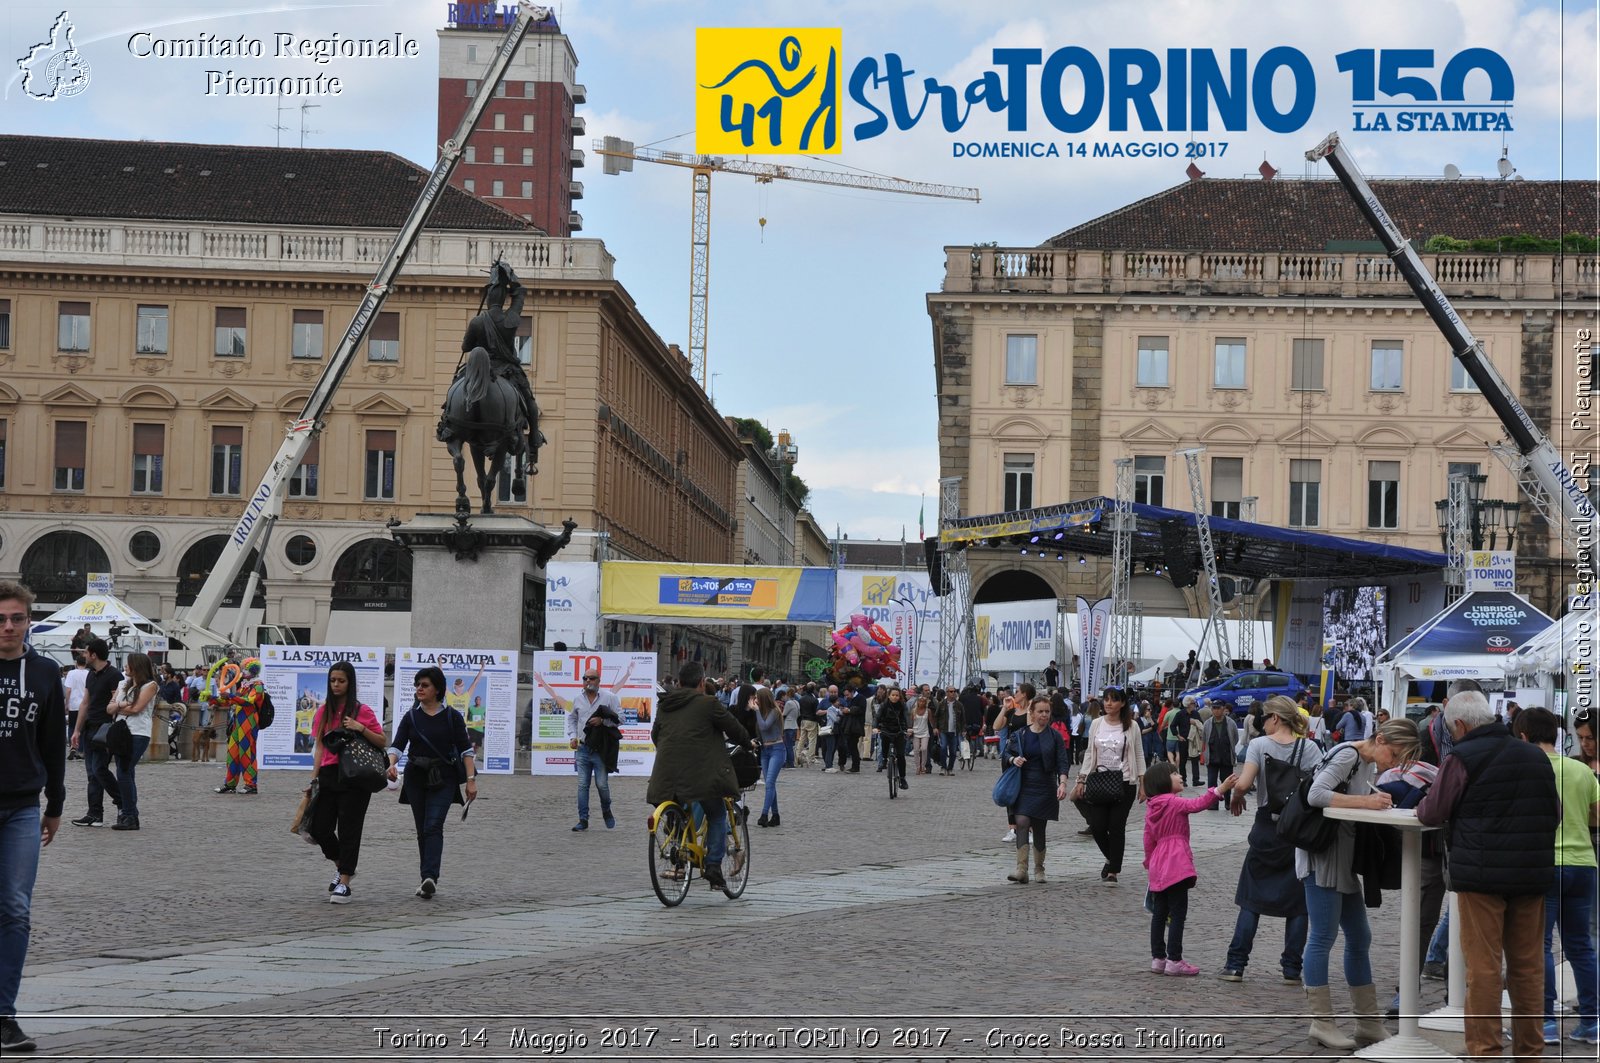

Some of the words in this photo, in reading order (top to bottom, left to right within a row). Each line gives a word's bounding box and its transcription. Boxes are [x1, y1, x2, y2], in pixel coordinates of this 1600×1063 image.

[1434, 293, 1460, 325] ARDUINO
[346, 298, 375, 344] ARDUINO
[233, 483, 271, 551] ARDUINO
[1473, 568, 1514, 580] TORINO
[1493, 580, 1514, 588] 150
[547, 598, 573, 607] 150
[1463, 611, 1527, 619] CONTAGIA
[1471, 618, 1521, 626] TORINO.
[1033, 619, 1052, 639] 150
[281, 650, 302, 661] LA
[304, 651, 363, 662] STAMPA
[417, 653, 436, 664] LA
[438, 653, 496, 665] STAMPA
